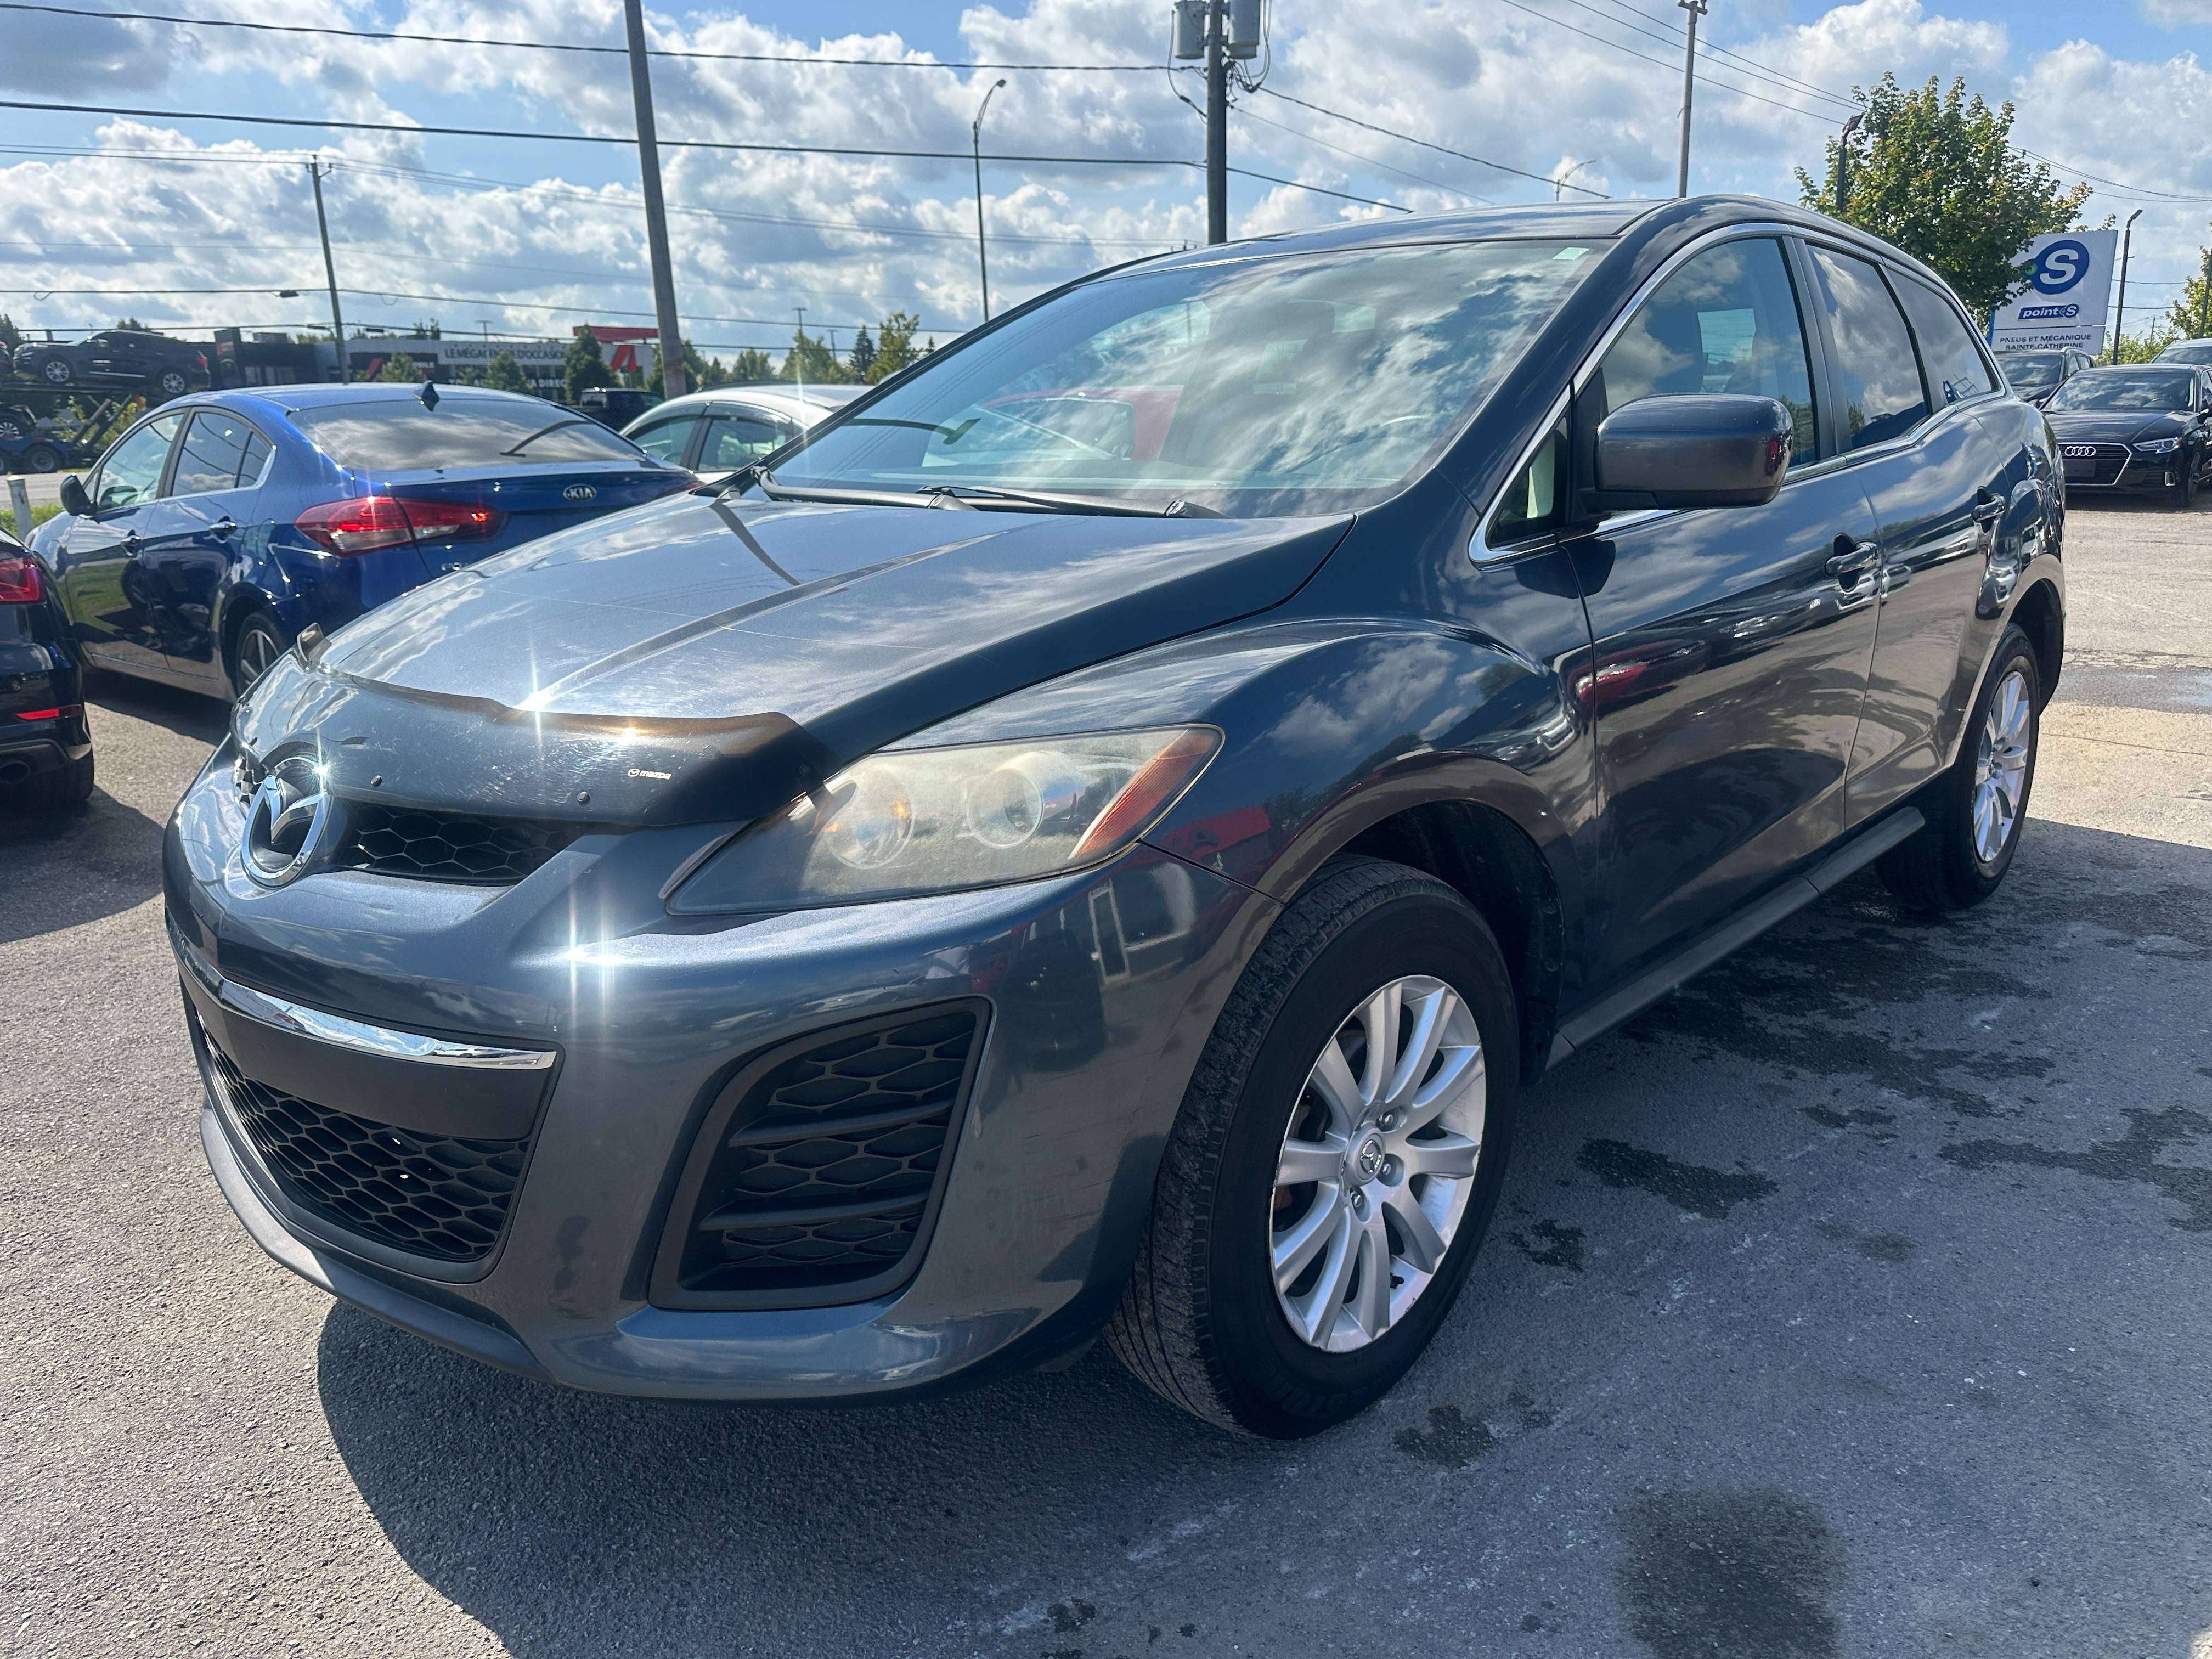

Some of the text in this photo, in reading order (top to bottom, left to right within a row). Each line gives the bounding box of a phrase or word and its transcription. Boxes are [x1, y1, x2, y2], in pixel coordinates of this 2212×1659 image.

[2040, 249, 2079, 285] S
[2022, 306, 2076, 318] point S
[570, 488, 594, 499] KIA
